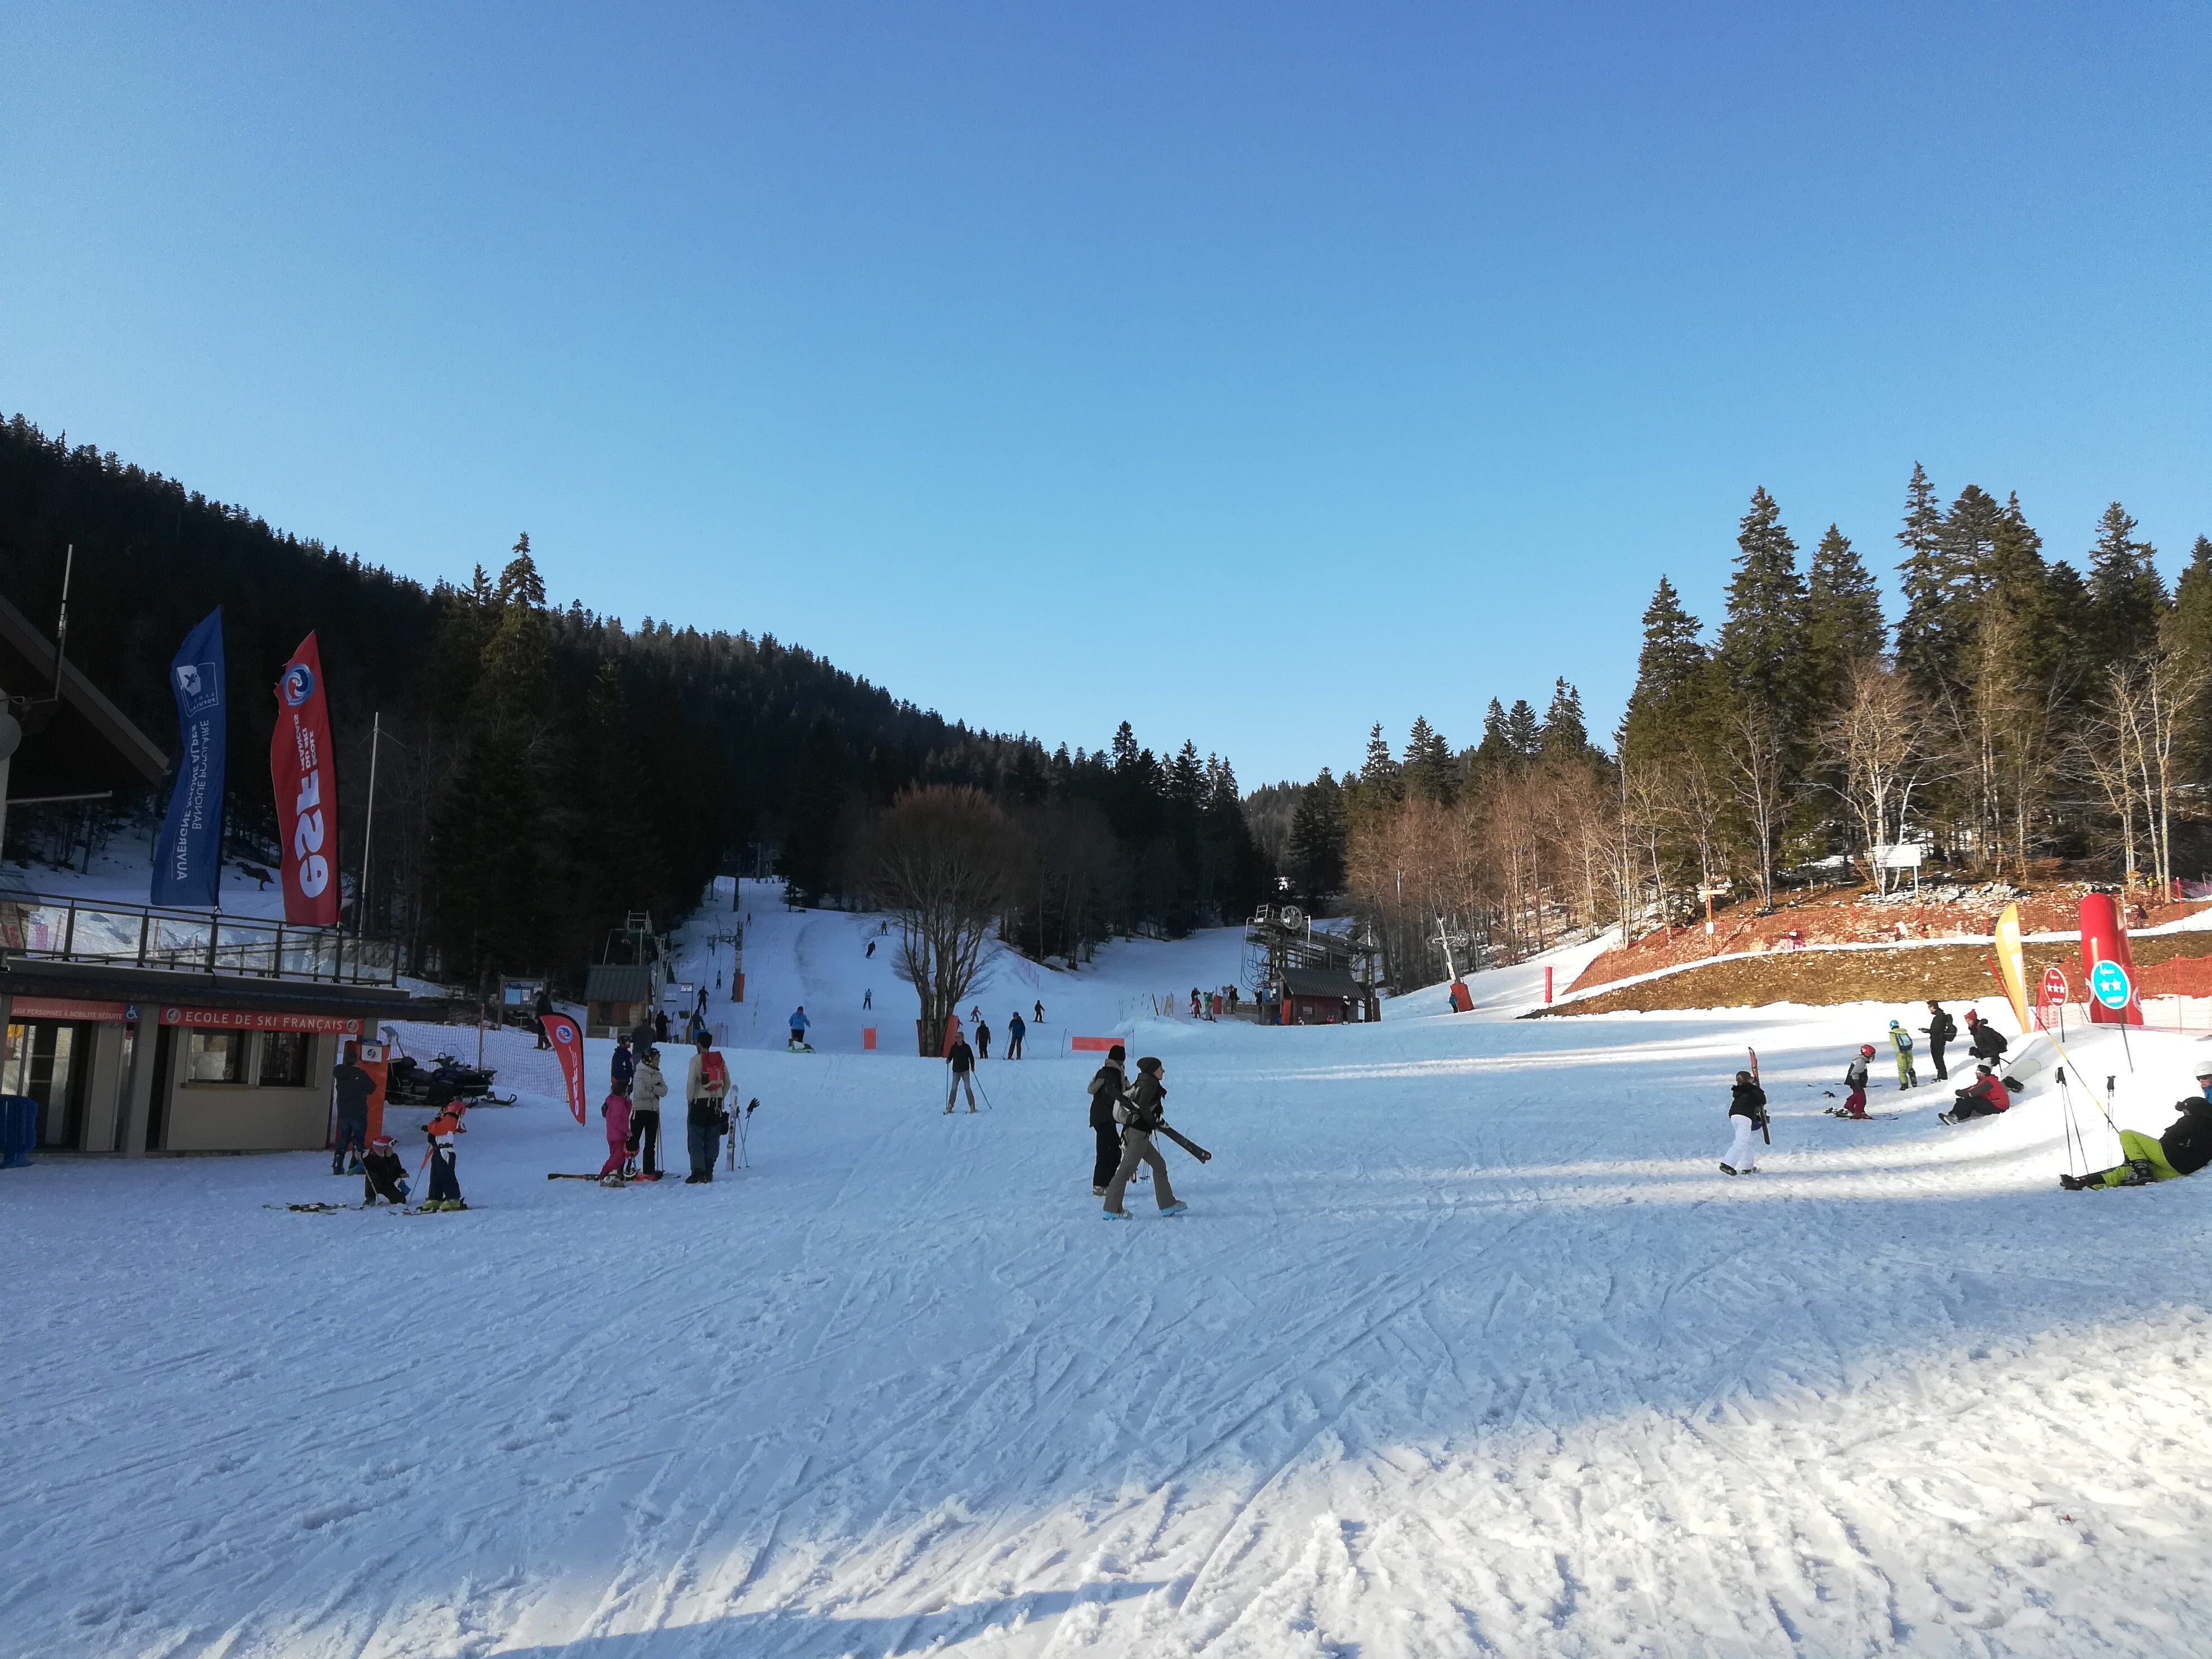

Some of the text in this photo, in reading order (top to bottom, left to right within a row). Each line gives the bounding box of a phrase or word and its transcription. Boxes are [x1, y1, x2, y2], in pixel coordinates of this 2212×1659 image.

[186, 1012, 342, 1032] ECOLE DE SKI FRANÇAIS
